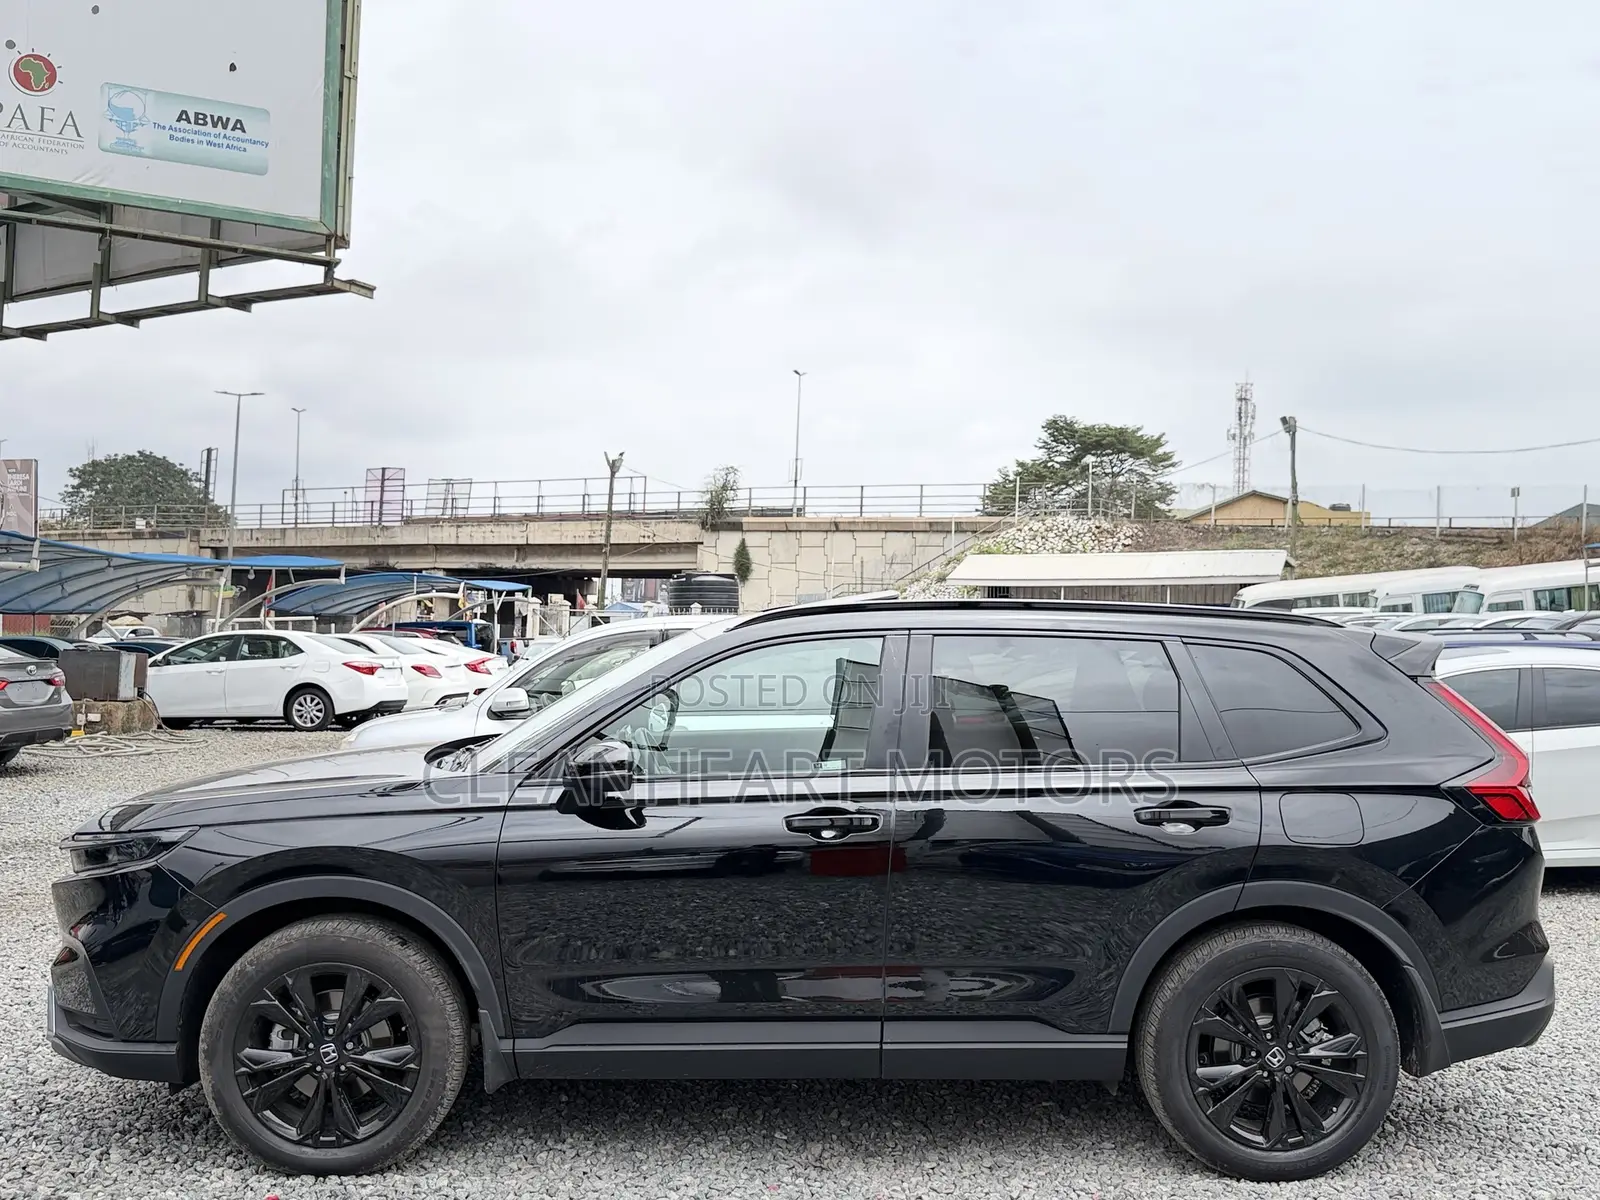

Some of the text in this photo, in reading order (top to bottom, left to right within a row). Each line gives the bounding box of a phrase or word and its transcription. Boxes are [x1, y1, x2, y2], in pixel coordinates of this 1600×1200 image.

[0, 102, 84, 138] AFA
[176, 109, 247, 134] ABWA
[0, 133, 85, 150] AFRICAN FEDERATION
[152, 122, 166, 131] The
[168, 125, 212, 138] Association
[222, 133, 270, 149] Accountancy
[169, 134, 247, 153] Bodies in West Africa
[12, 142, 68, 155] ACCOUNTANTS
